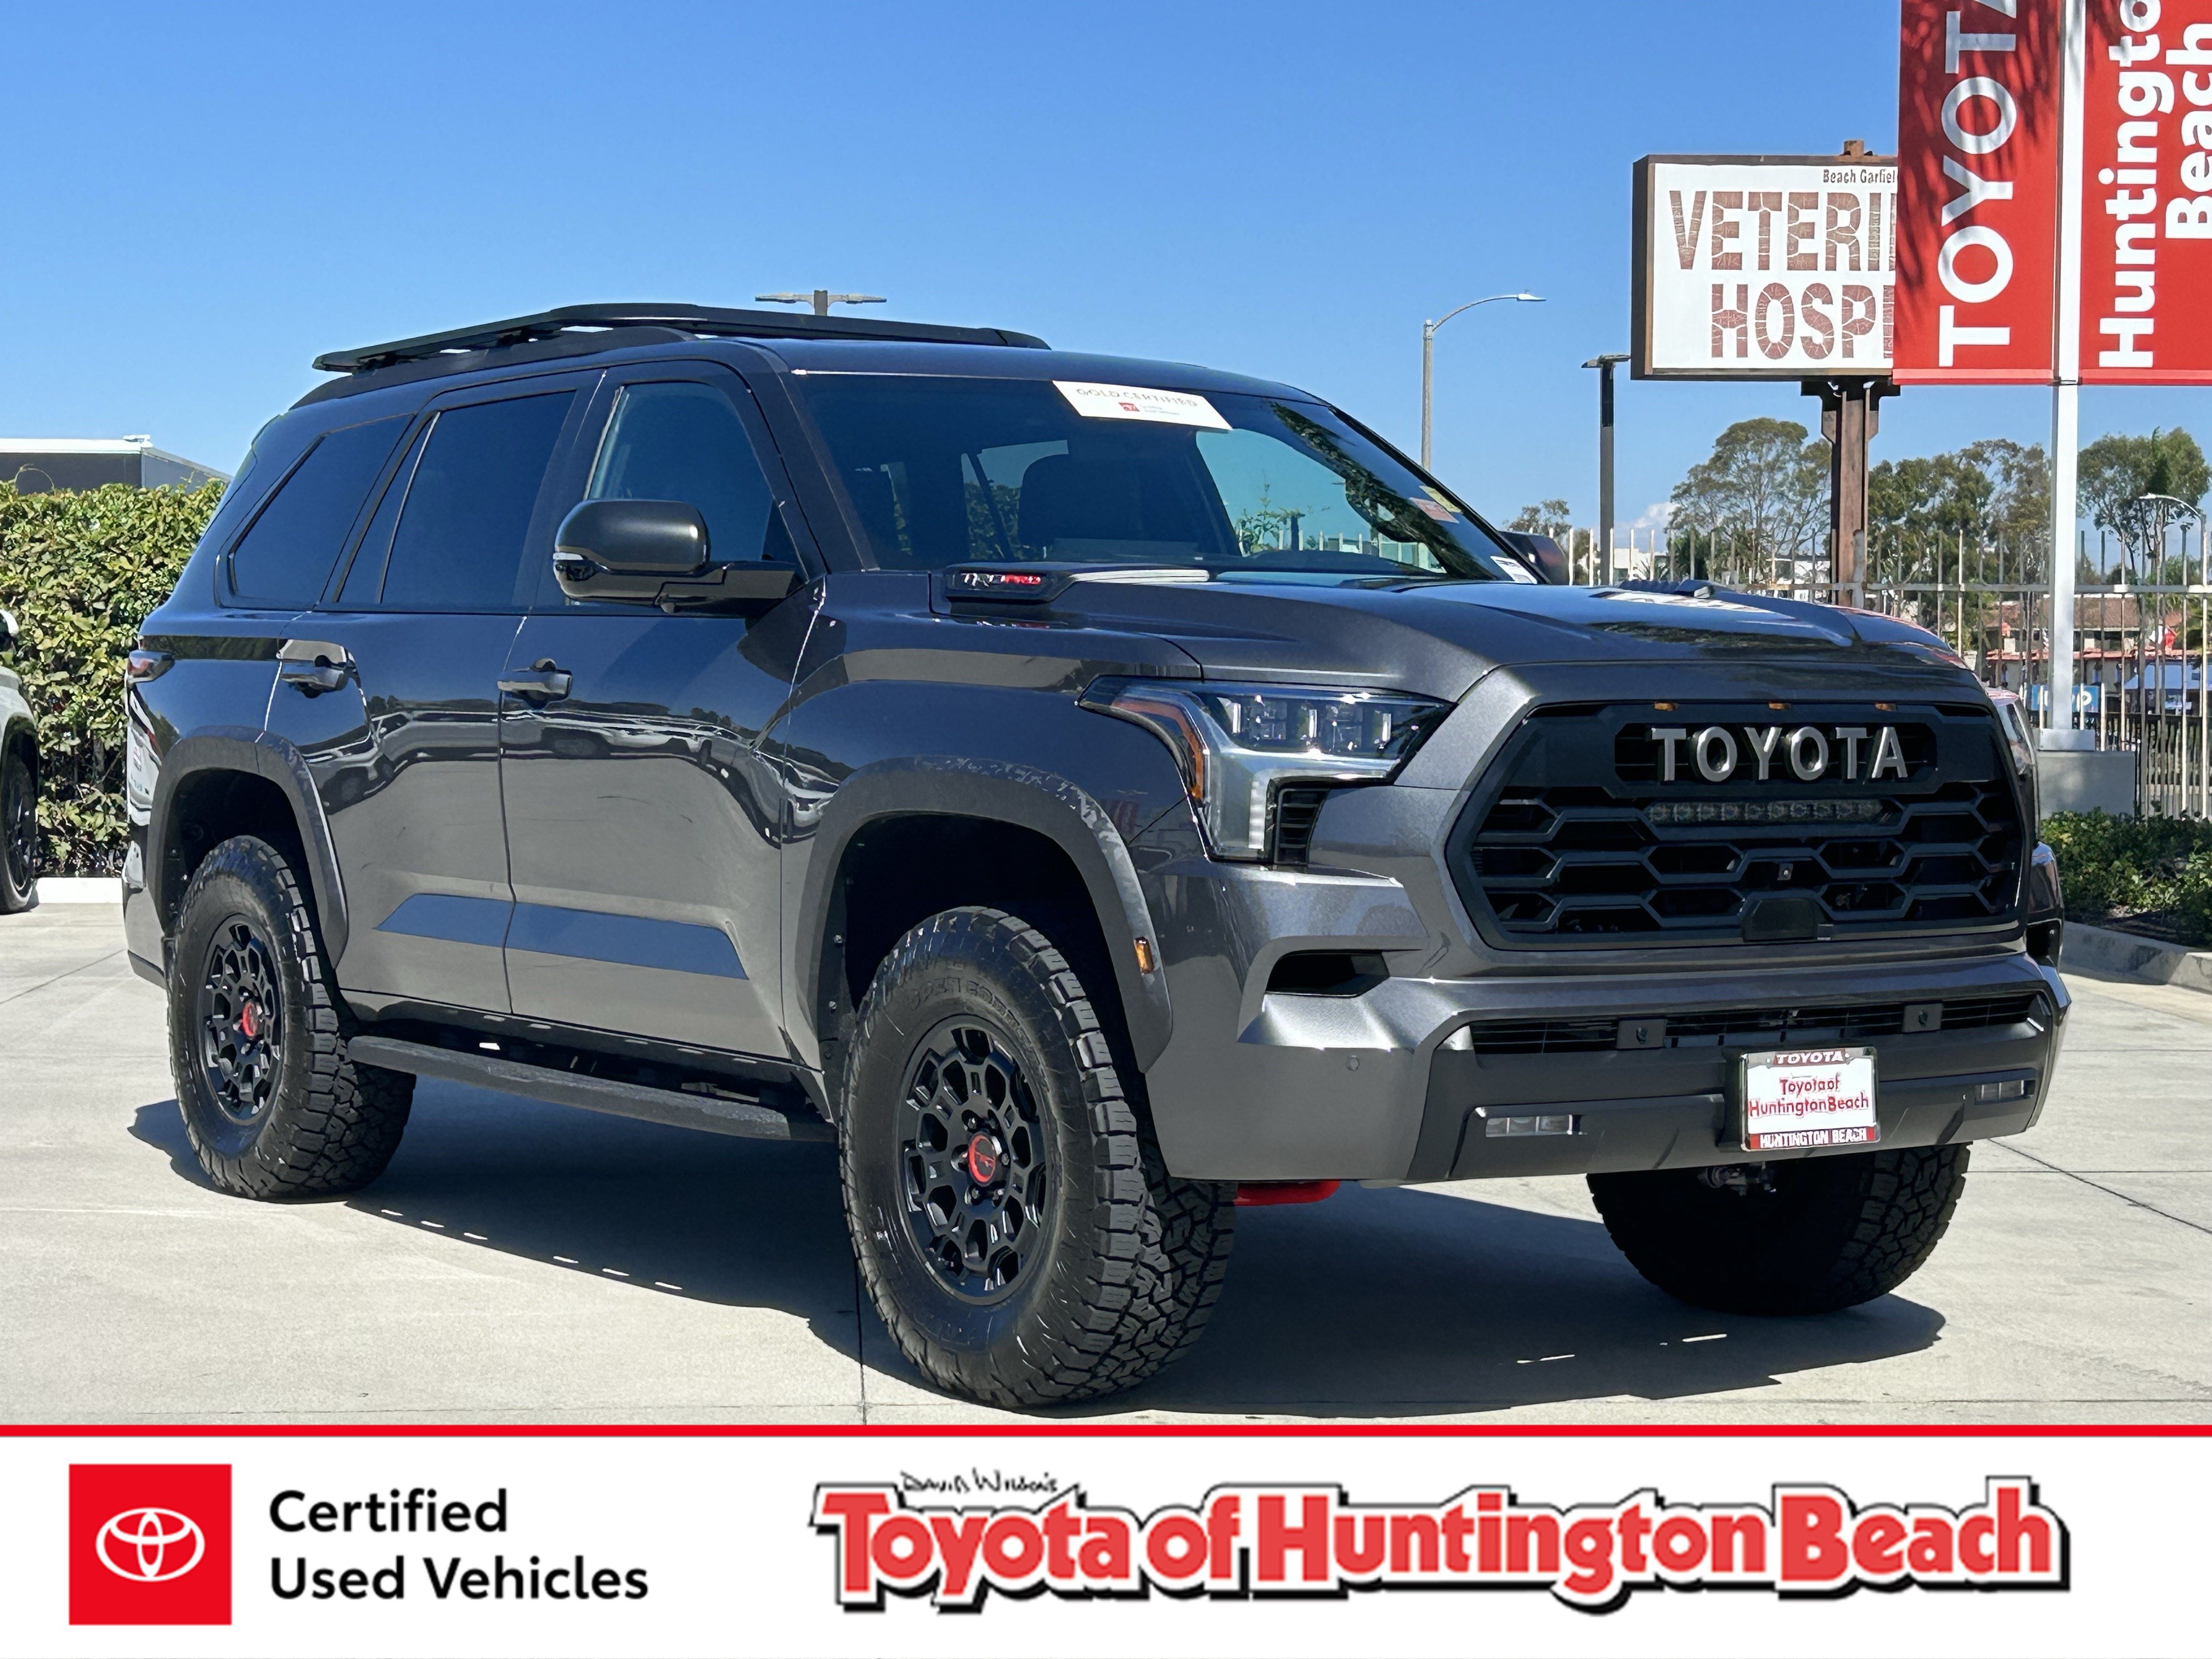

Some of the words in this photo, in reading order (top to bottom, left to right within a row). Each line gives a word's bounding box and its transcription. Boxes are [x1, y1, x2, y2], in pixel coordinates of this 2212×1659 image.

[2165, 23, 2212, 239] Beach
[1823, 169, 1856, 183] Beach
[1938, 0, 2017, 366] TOYOT
[2098, 0, 2174, 368] Huntingto
[1669, 190, 1897, 271] VETERI
[1711, 283, 1894, 360] HOSPI
[1651, 726, 1908, 782] TOYOTA
[1776, 1051, 1844, 1065] TOYOTA
[1759, 1130, 1829, 1149] HUNTINGTON
[1832, 1127, 1867, 1144] BEACH
